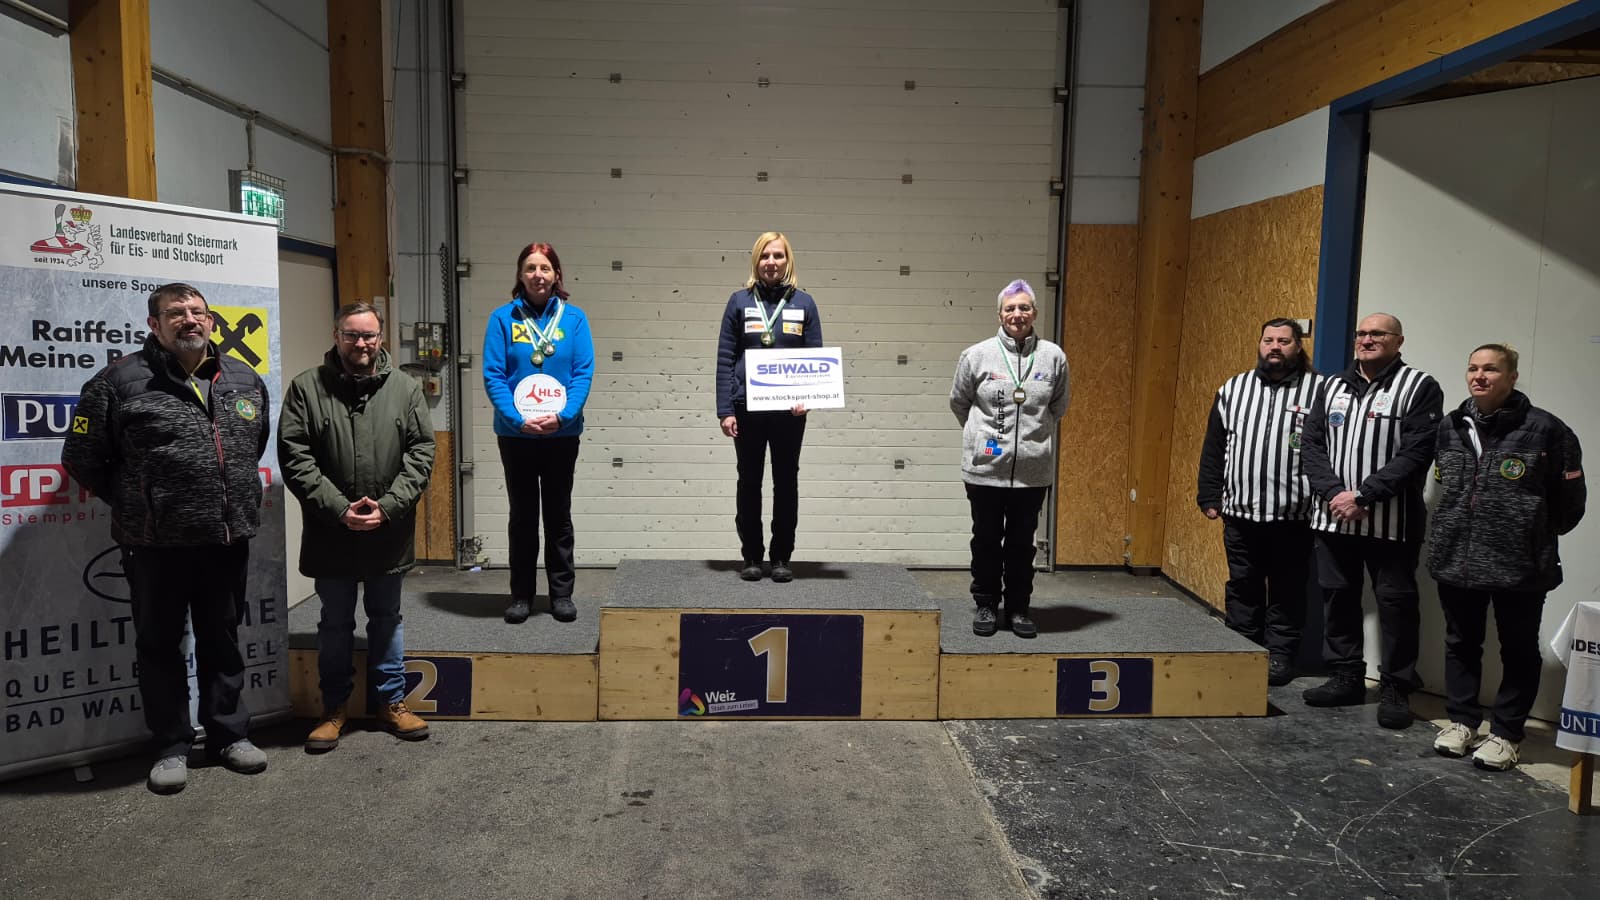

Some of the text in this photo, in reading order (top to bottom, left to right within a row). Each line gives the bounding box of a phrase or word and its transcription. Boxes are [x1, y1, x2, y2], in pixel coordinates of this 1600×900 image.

[110, 223, 238, 250] Landesverband Steiermark
[110, 241, 224, 266] für Eis- und Stocksport
[82, 278, 127, 290] unsere
[32, 319, 146, 345] Raiffeis
[0, 345, 95, 369] Meine
[756, 362, 830, 375] SEIWALD
[538, 388, 562, 398] HLS
[752, 393, 840, 401] www.stocksport-shop.at
[17, 399, 77, 434] PU
[2, 507, 105, 526] Stempel-
[748, 626, 789, 703] 1
[402, 659, 437, 712] 2
[705, 689, 736, 704] Weiz
[1088, 660, 1121, 712] 3
[6, 706, 65, 733] BAD
